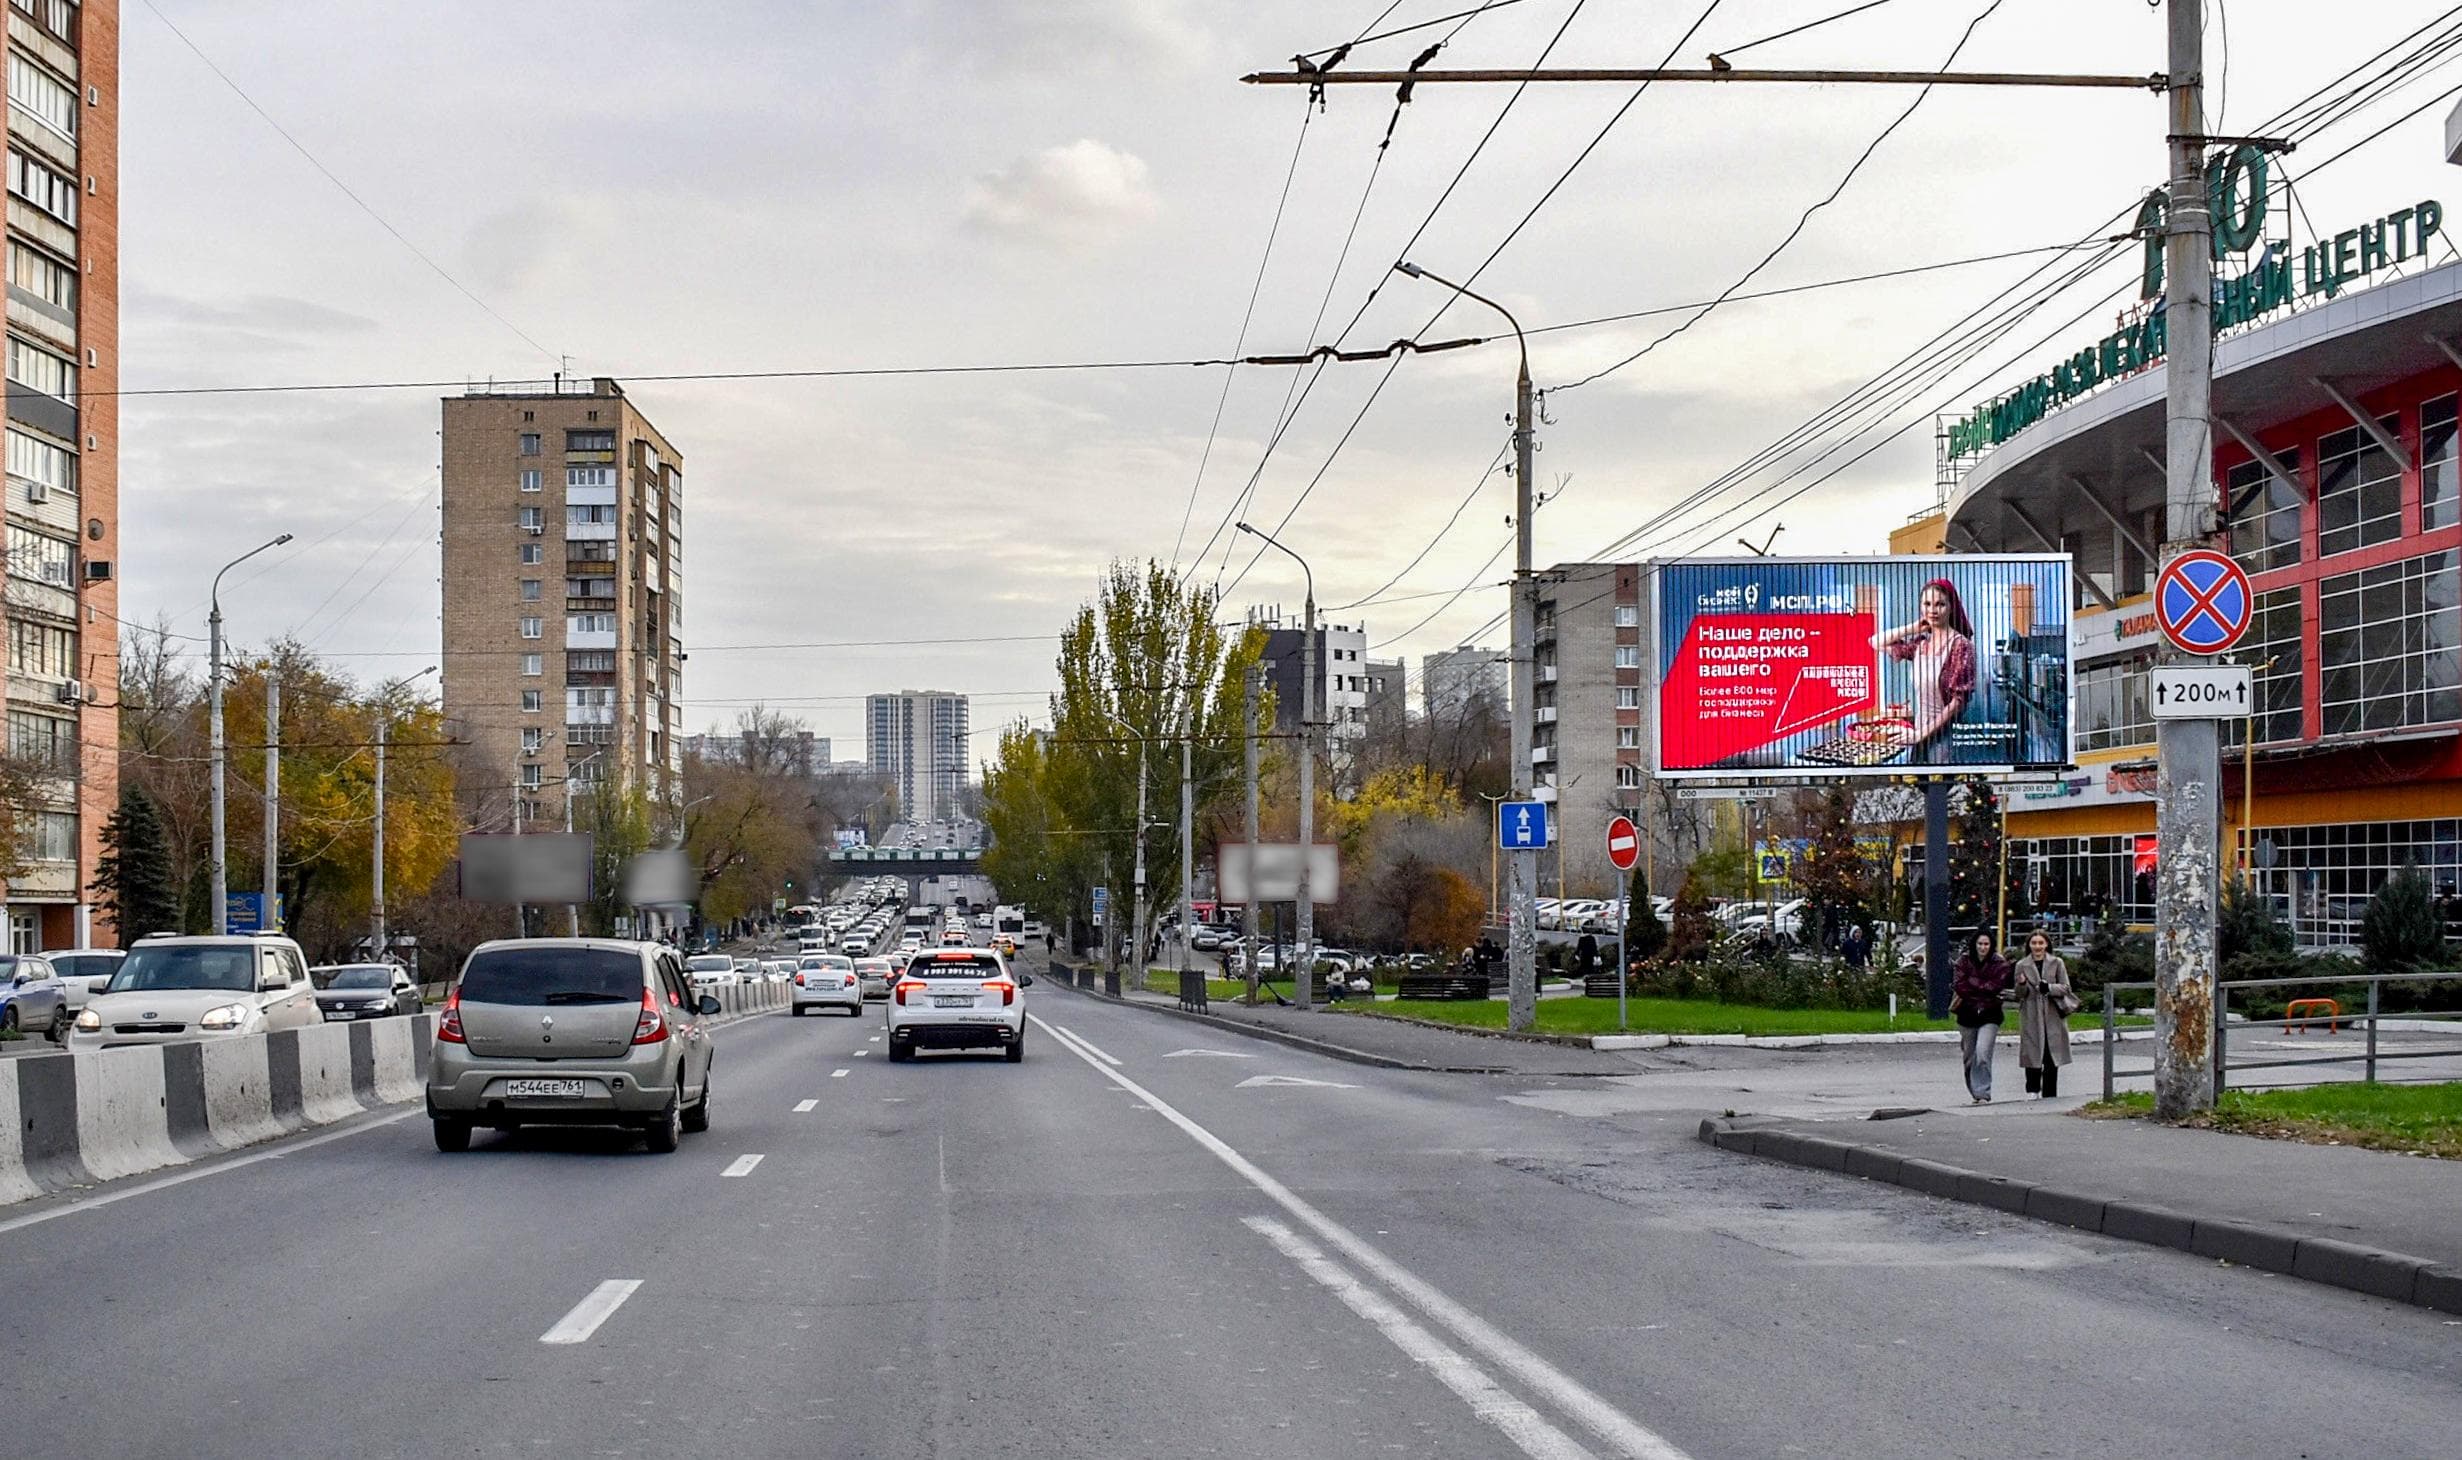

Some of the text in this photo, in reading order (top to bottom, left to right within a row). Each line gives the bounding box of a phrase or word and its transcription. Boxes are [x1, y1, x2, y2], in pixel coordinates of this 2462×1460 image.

[2304, 200, 2442, 299] ЦЕНТР
[1699, 626, 1752, 641] Наше
[1757, 627, 1806, 643] дело
[1699, 645, 1809, 661] поддержка
[1699, 663, 1771, 677] вашего
[1699, 686, 1731, 696] Более
[1721, 709, 1765, 718] бизнеса
